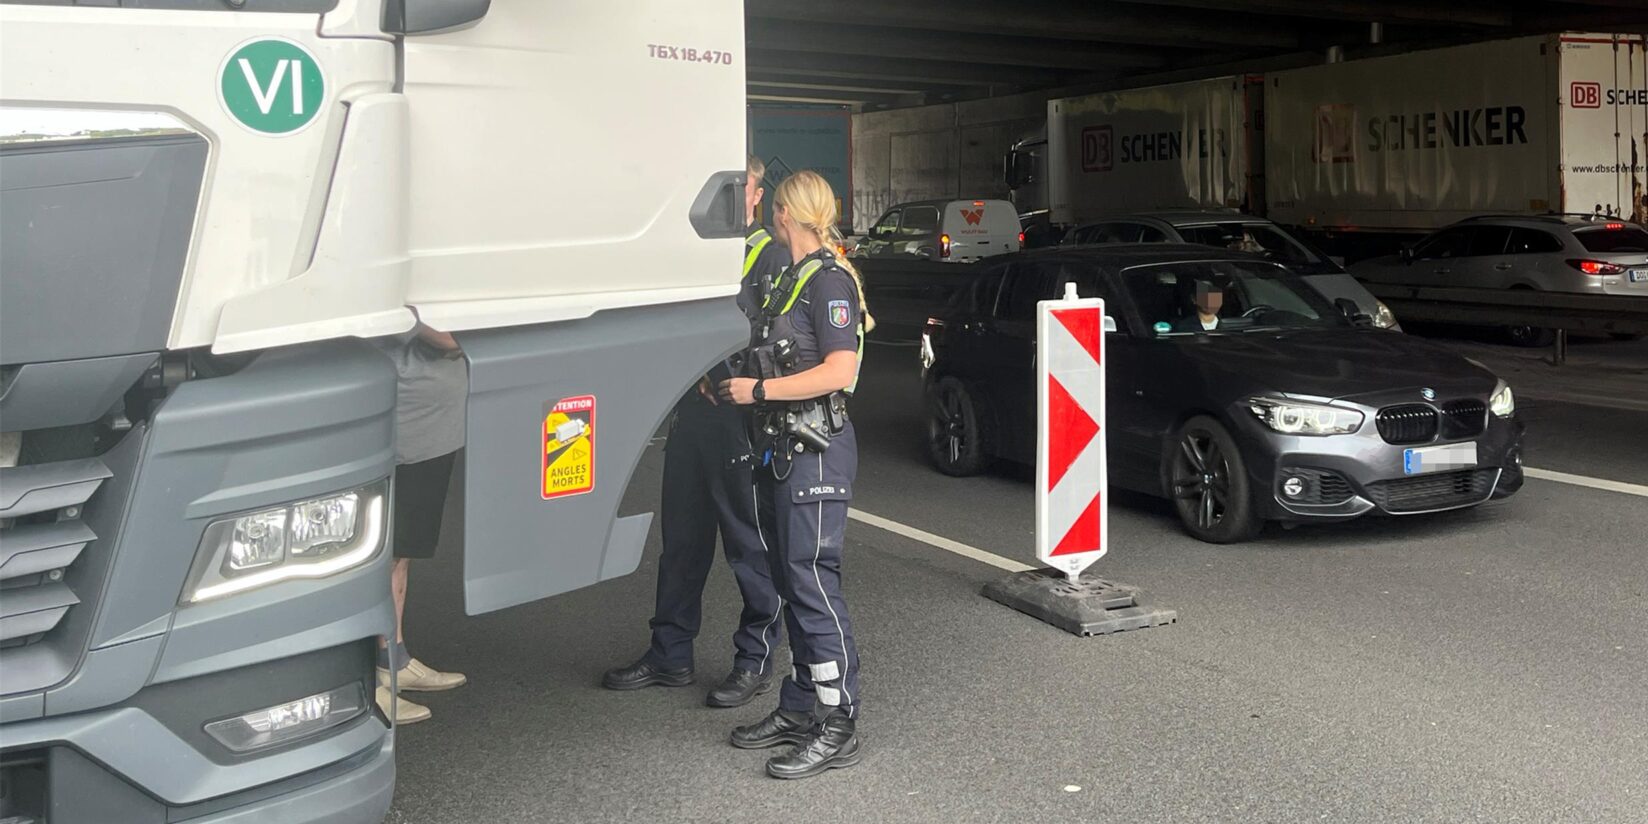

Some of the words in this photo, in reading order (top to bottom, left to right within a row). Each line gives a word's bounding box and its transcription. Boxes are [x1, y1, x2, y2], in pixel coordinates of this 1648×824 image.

[237, 58, 303, 114] VI
[1574, 86, 1597, 104] DB
[1120, 129, 1226, 163] SCHENER
[551, 464, 586, 478] ANGLES
[552, 474, 585, 488] MORTS
